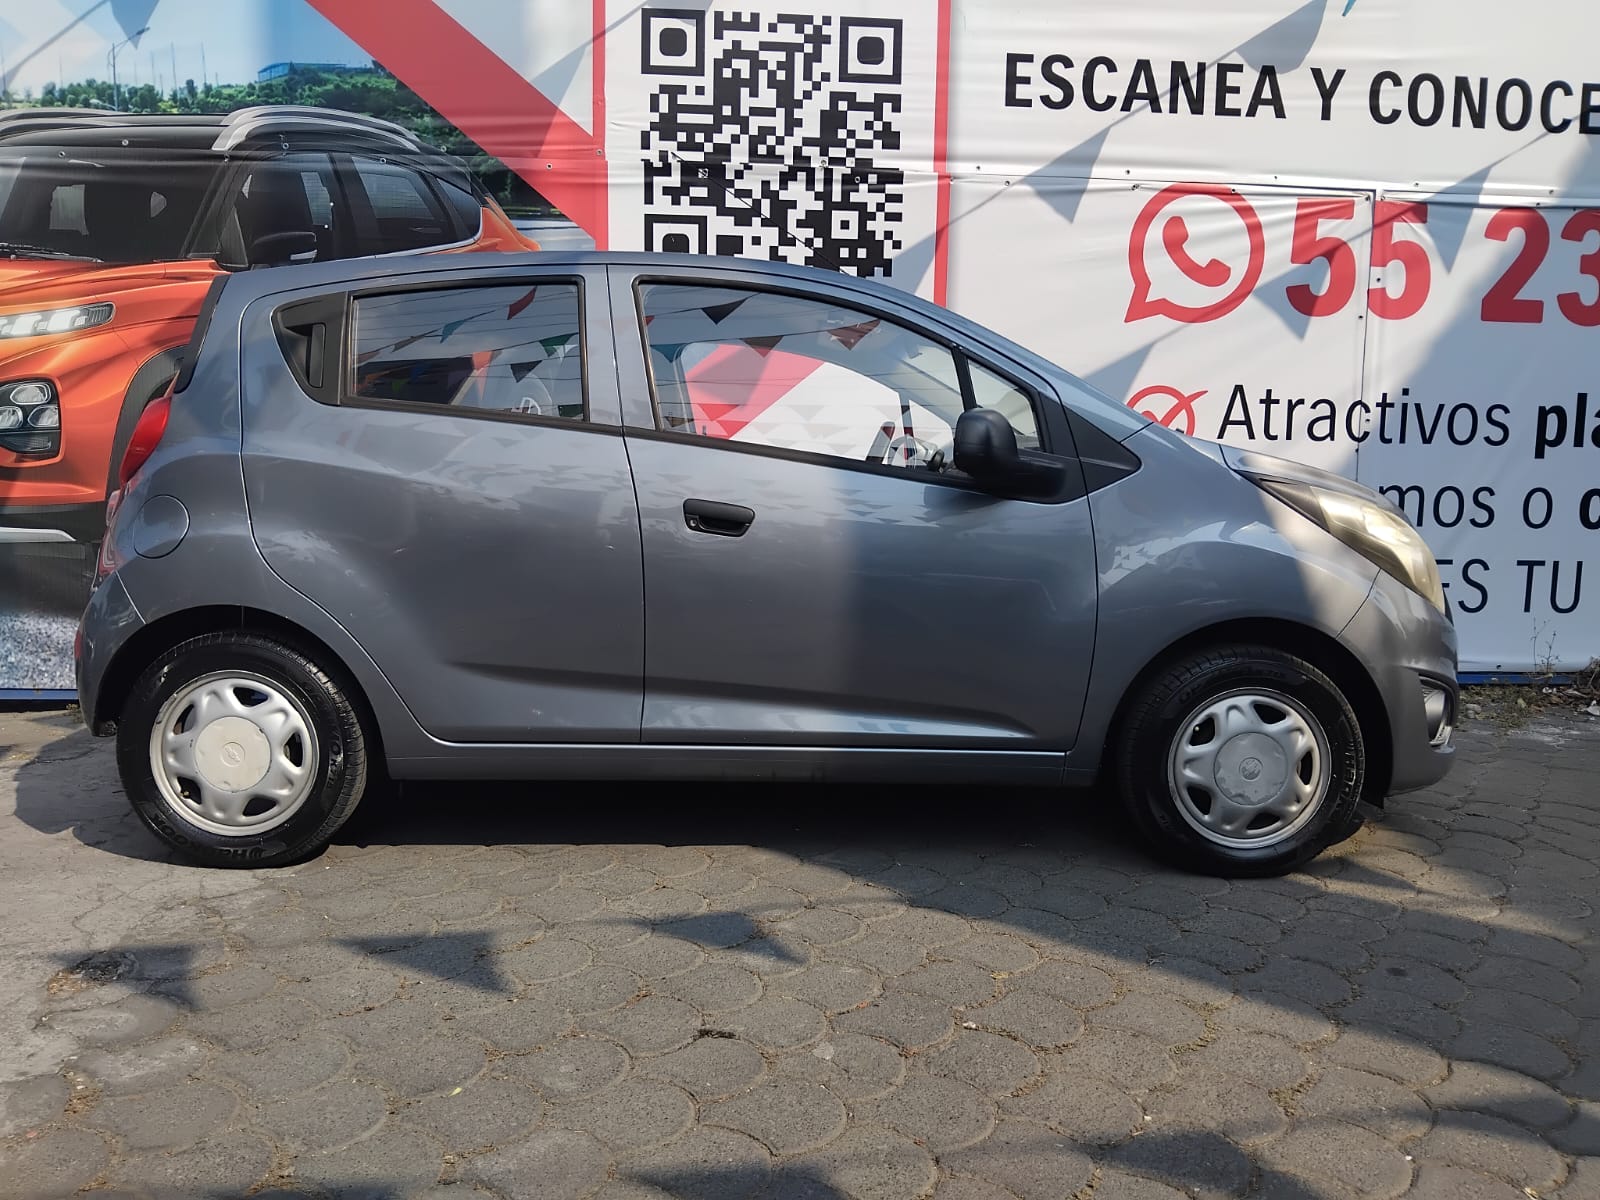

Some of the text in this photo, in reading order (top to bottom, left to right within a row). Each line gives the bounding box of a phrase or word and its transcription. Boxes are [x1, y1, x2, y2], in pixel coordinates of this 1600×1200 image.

[1004, 52, 1600, 135] ESCANEA Y CONOCE
[1285, 196, 1600, 327] 55 23
[1217, 384, 1511, 446] Atractivos
[1522, 487, 1553, 529] o
[1516, 560, 1583, 614] TU
